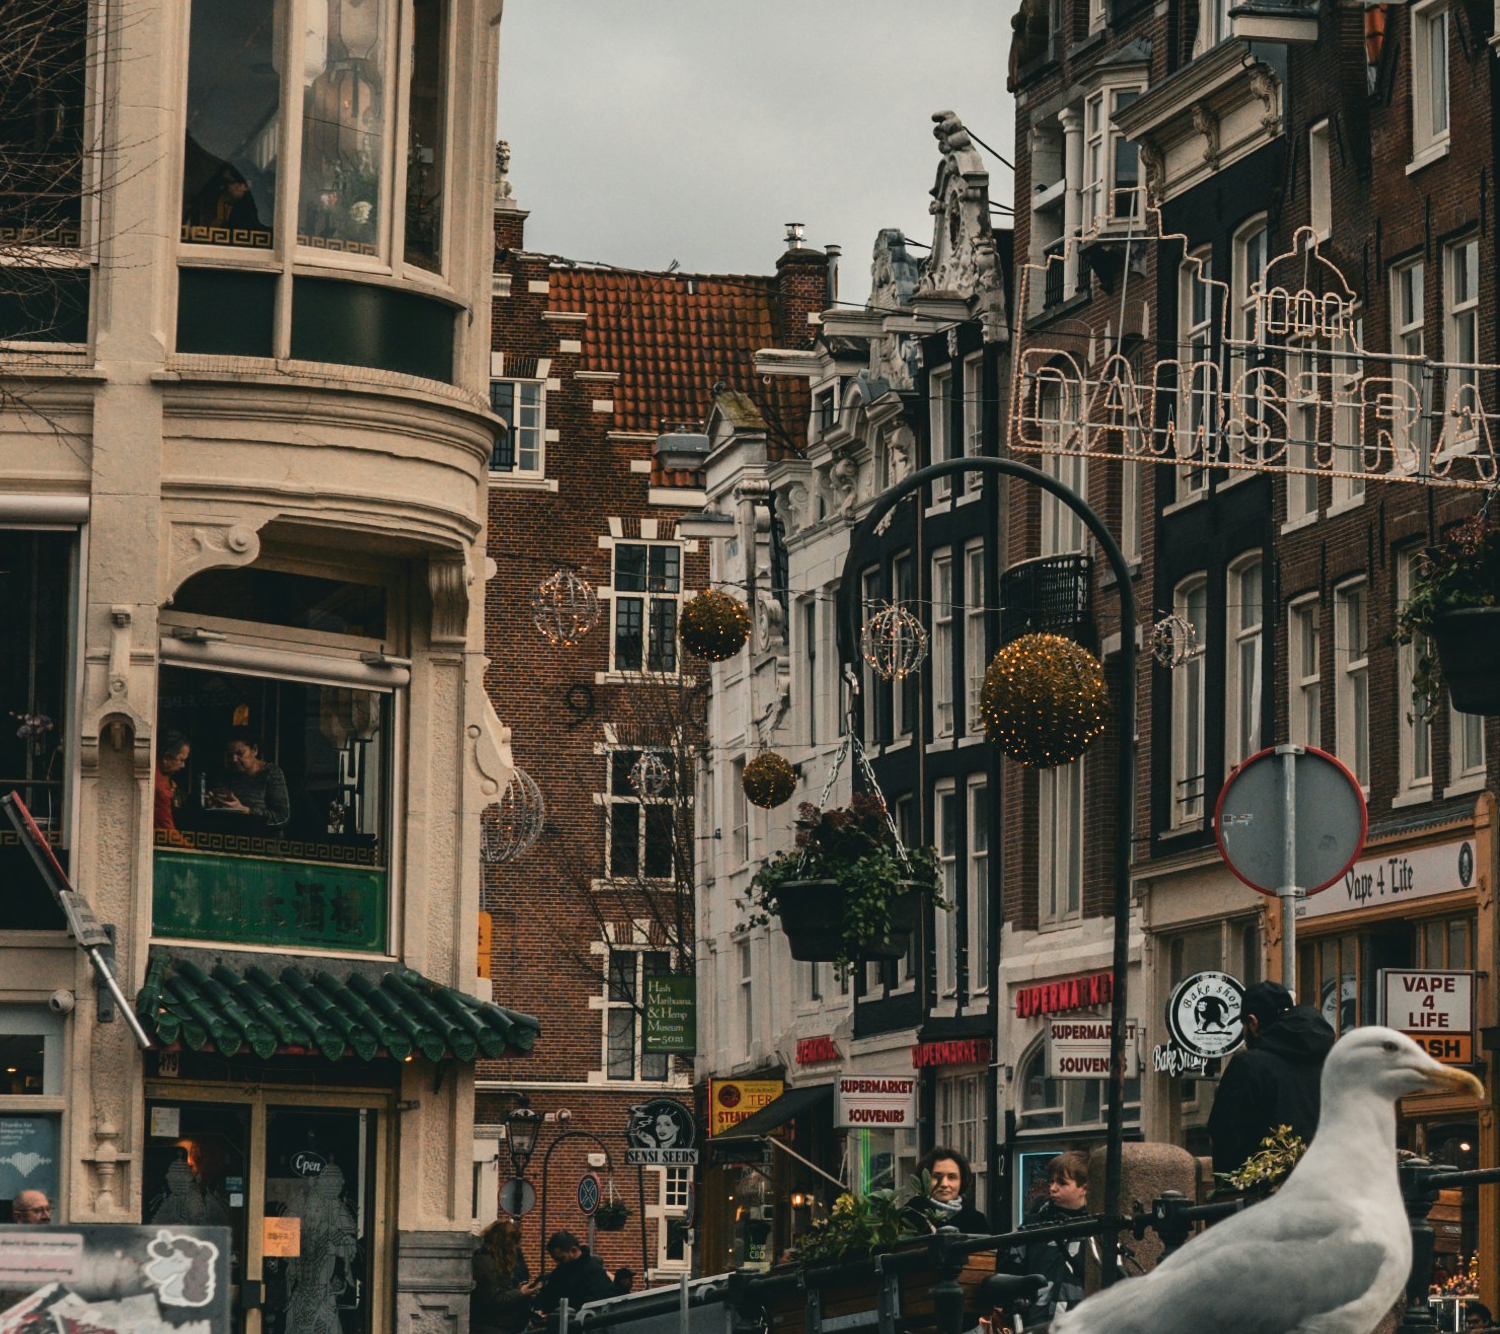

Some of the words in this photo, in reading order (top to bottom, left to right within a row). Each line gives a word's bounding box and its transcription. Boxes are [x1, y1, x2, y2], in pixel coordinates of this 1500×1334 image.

[1345, 870, 1373, 905] Vape
[1377, 872, 1385, 895] 4
[1390, 858, 1414, 895] Life
[648, 981, 671, 993] Hash
[1403, 977, 1455, 992] VAPE
[1183, 984, 1210, 1010] Bake
[1422, 995, 1434, 1010] 4
[661, 1007, 687, 1021] Hemp
[1409, 1012, 1449, 1027] LIFE
[647, 1020, 684, 1032] Museum
[1051, 1024, 1134, 1040] SUPERMARET
[661, 1034, 683, 1043] 50m
[840, 1079, 914, 1094] SUPERMARKET
[849, 1109, 905, 1123] SOUVENIRS
[629, 1150, 658, 1163] SENSI
[663, 1150, 695, 1163] SEEDS
[295, 1155, 321, 1174] Open
